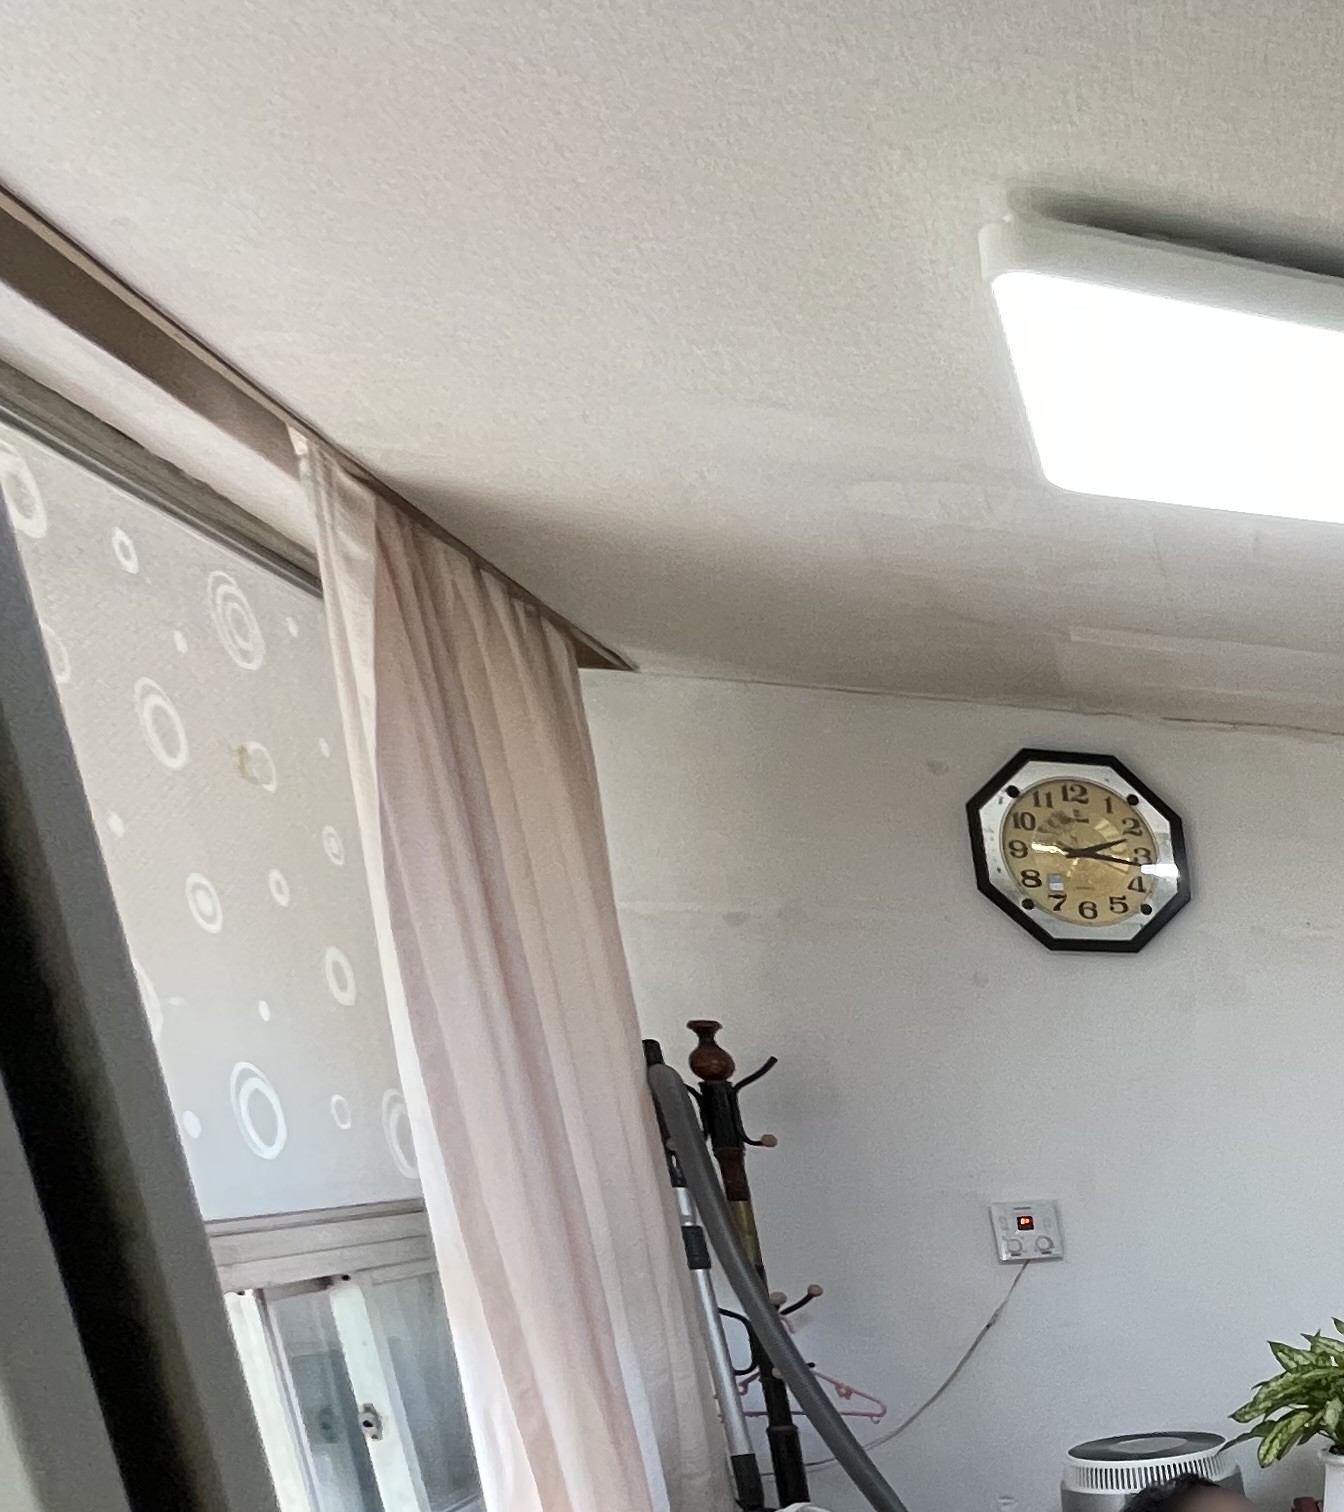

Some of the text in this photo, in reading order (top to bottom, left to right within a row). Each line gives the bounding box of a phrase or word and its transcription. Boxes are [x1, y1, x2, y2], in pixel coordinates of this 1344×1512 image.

[1032, 790, 1054, 809] 11
[1061, 784, 1089, 805] 12
[1105, 797, 1113, 814] 1
[1012, 811, 1037, 832] 10
[1122, 817, 1144, 837] 2
[1008, 840, 1029, 859] 9
[1020, 869, 1042, 888] 8
[1127, 876, 1146, 893] 4
[1047, 894, 1067, 912] 7
[1078, 901, 1098, 920] 6
[1109, 896, 1129, 914] 5
